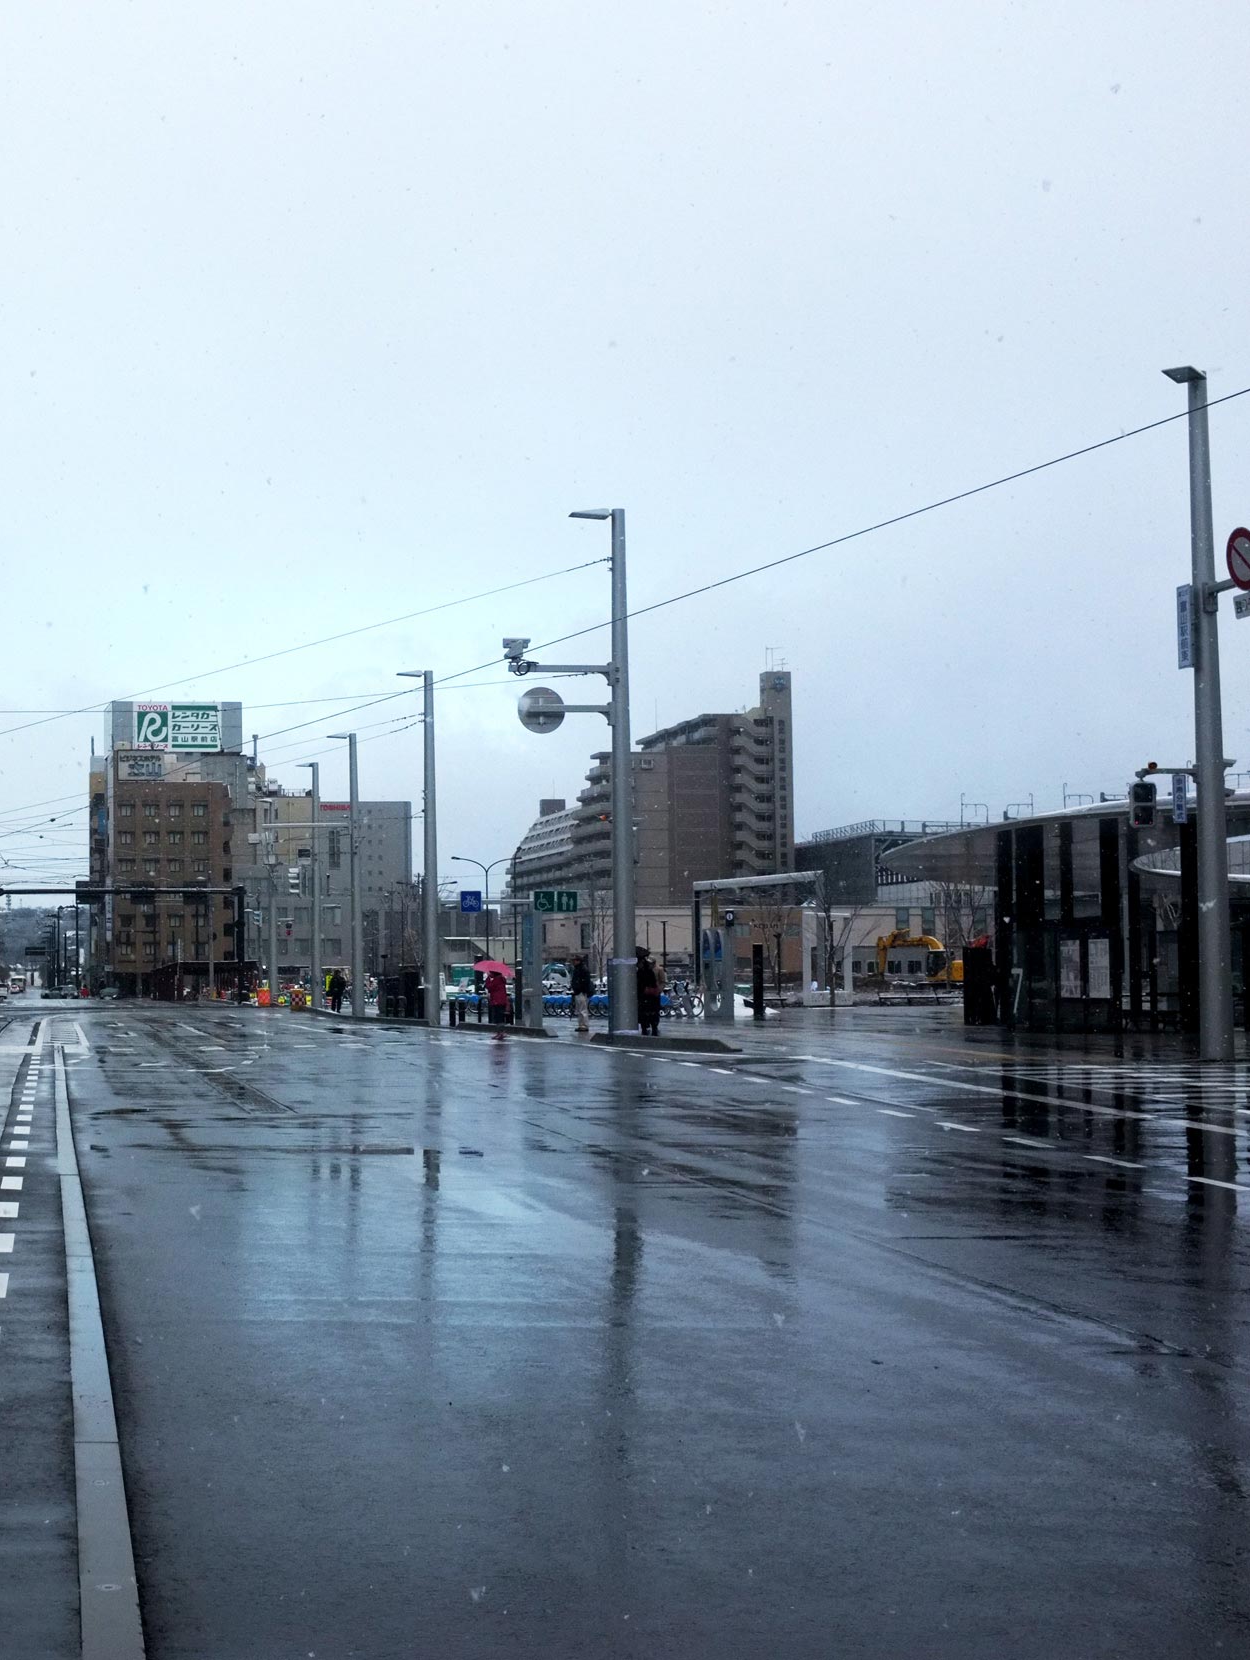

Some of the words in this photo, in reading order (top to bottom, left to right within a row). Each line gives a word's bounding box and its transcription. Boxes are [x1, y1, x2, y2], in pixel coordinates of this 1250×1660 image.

[171, 711, 218, 720] レンタカー
[171, 723, 218, 732] カーリース
[171, 735, 218, 743] 富山駅前店
